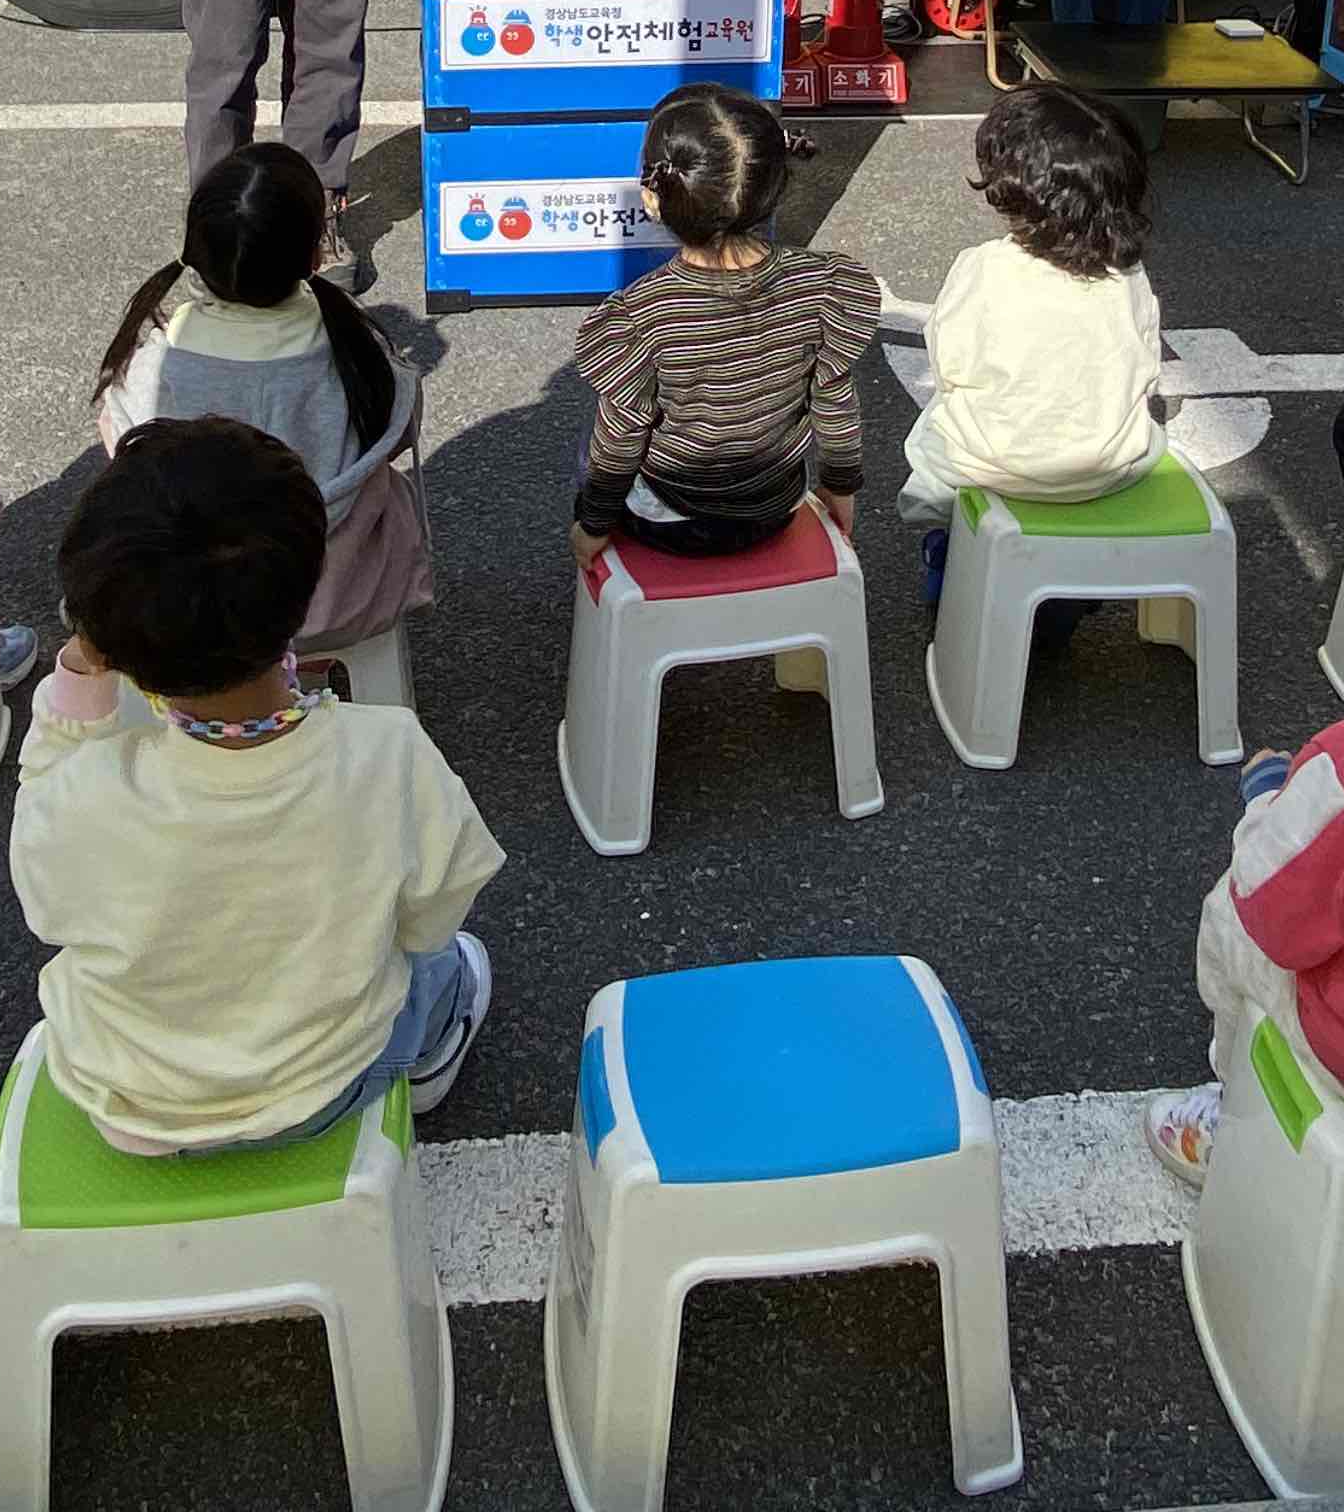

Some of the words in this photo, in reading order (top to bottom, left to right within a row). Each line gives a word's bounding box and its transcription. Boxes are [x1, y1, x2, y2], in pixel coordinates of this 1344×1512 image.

[544, 7, 622, 20] 경상남도교육청
[833, 69, 893, 88] 소화기
[542, 193, 617, 207] 경상남도교육청
